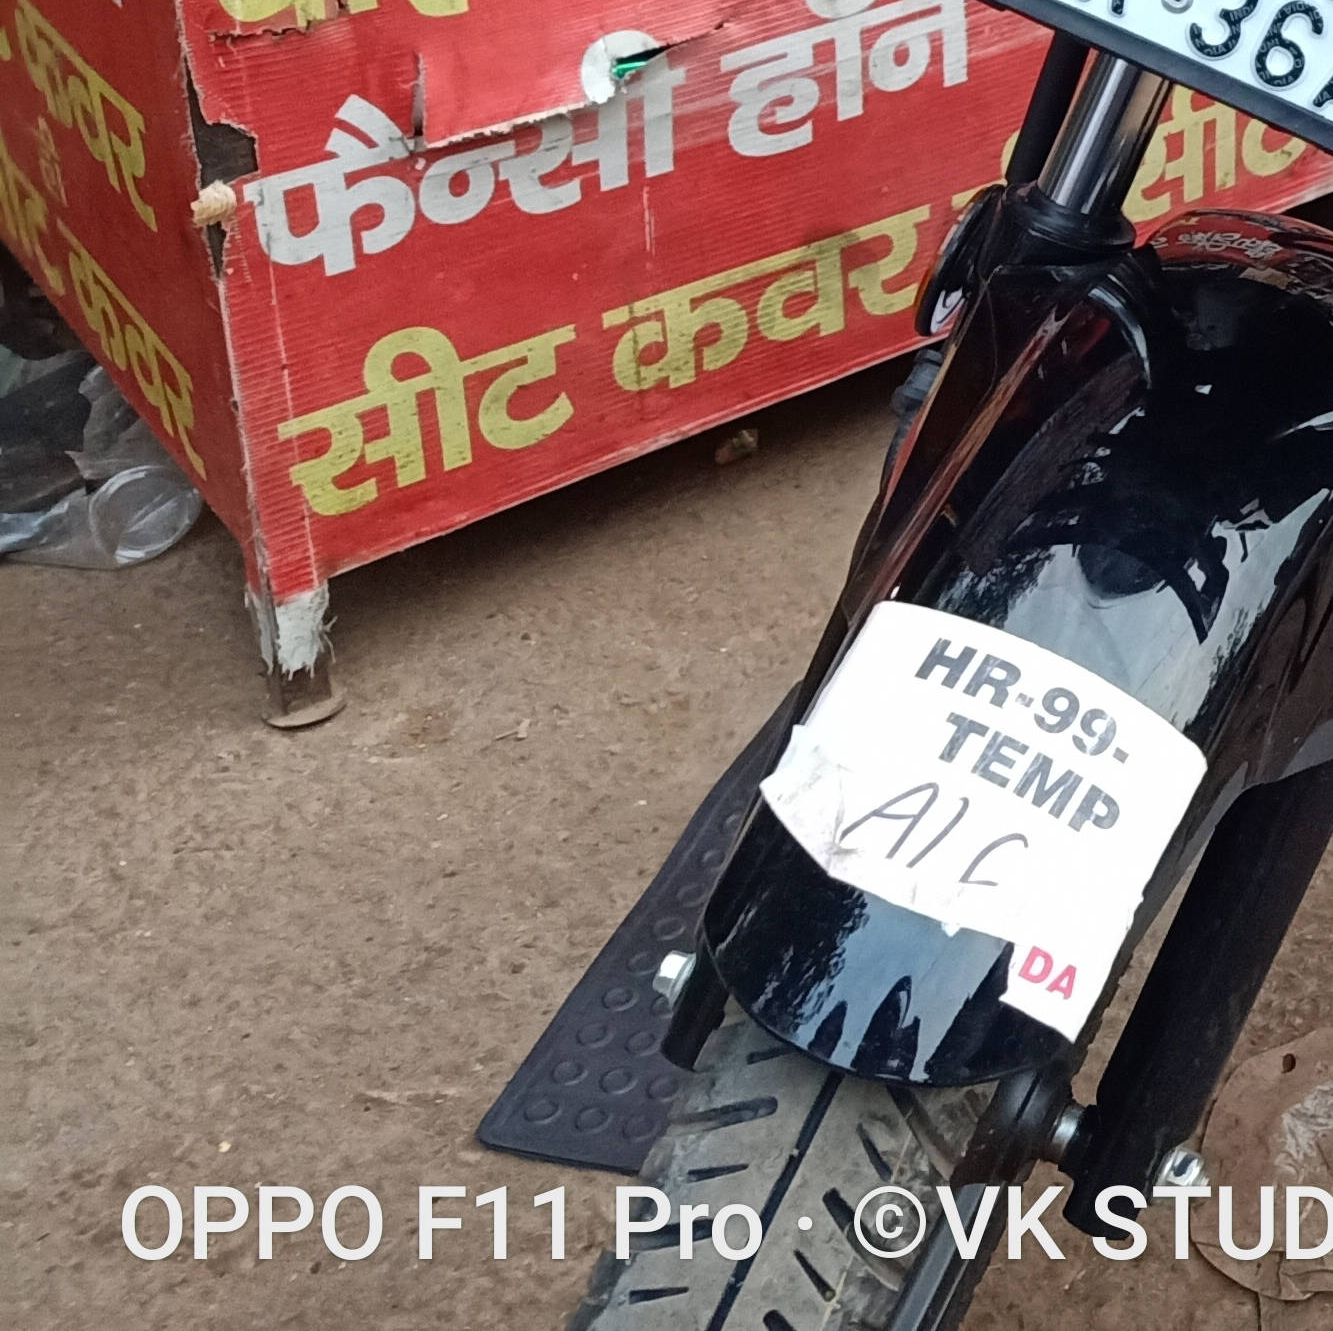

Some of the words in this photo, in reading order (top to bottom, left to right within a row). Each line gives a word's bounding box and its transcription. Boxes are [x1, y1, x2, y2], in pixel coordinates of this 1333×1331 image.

[277, 325, 577, 517] सीट
[602, 204, 931, 390] कवर
[937, 711, 1121, 835] TEMP
